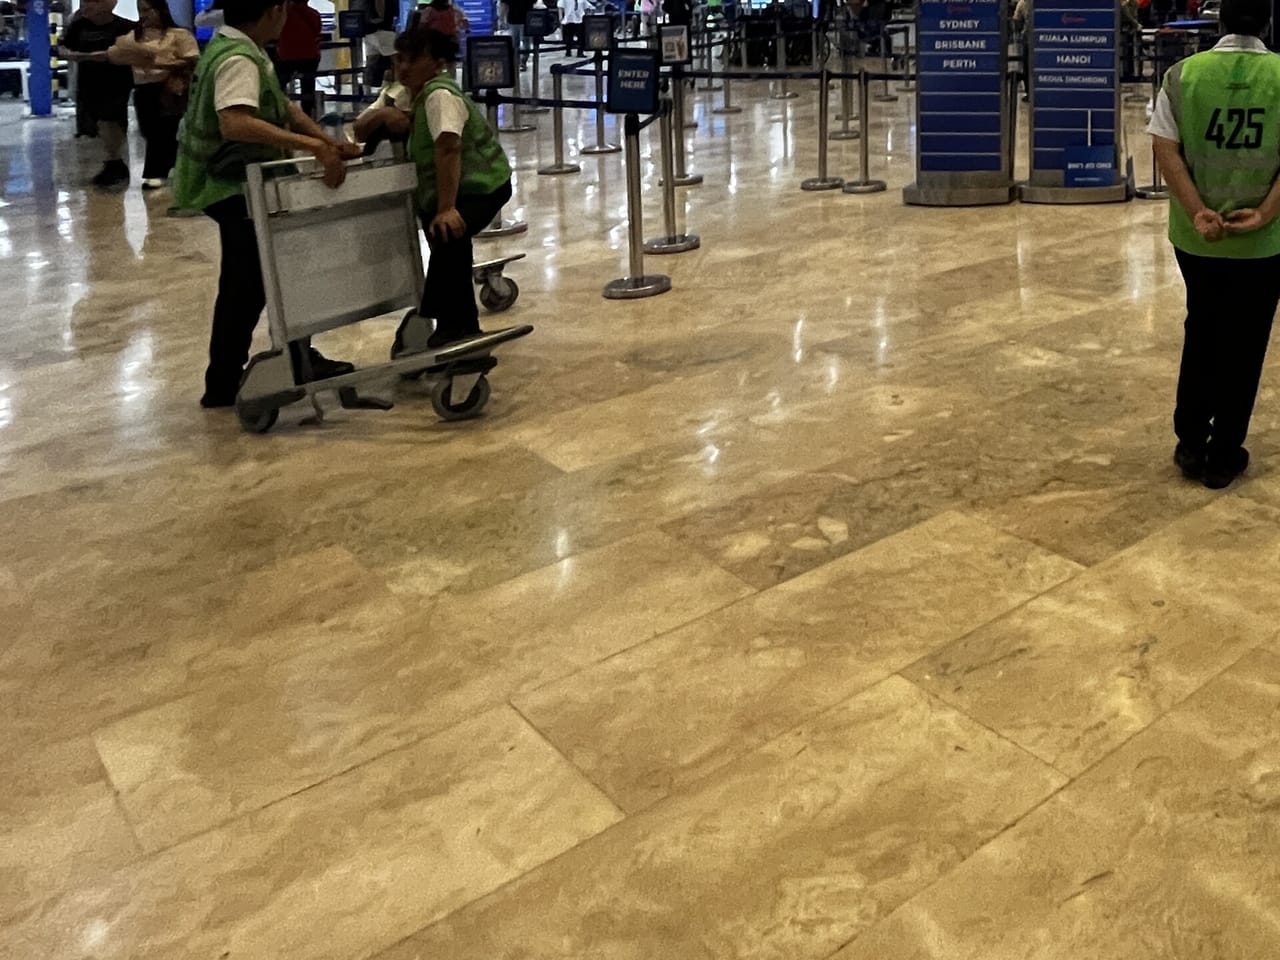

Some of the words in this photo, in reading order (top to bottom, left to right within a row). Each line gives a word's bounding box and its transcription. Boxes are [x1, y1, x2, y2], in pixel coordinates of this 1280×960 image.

[939, 20, 980, 29] SYDNEY
[1039, 34, 1068, 42] KUALA
[1070, 35, 1107, 44] LUMPUR
[934, 40, 986, 49] BRISBANE
[943, 58, 976, 69] PERTH
[1056, 55, 1091, 64] HANOI
[618, 69, 650, 79] ENTER
[620, 80, 647, 89] HERE
[1204, 108, 1265, 150] 425
